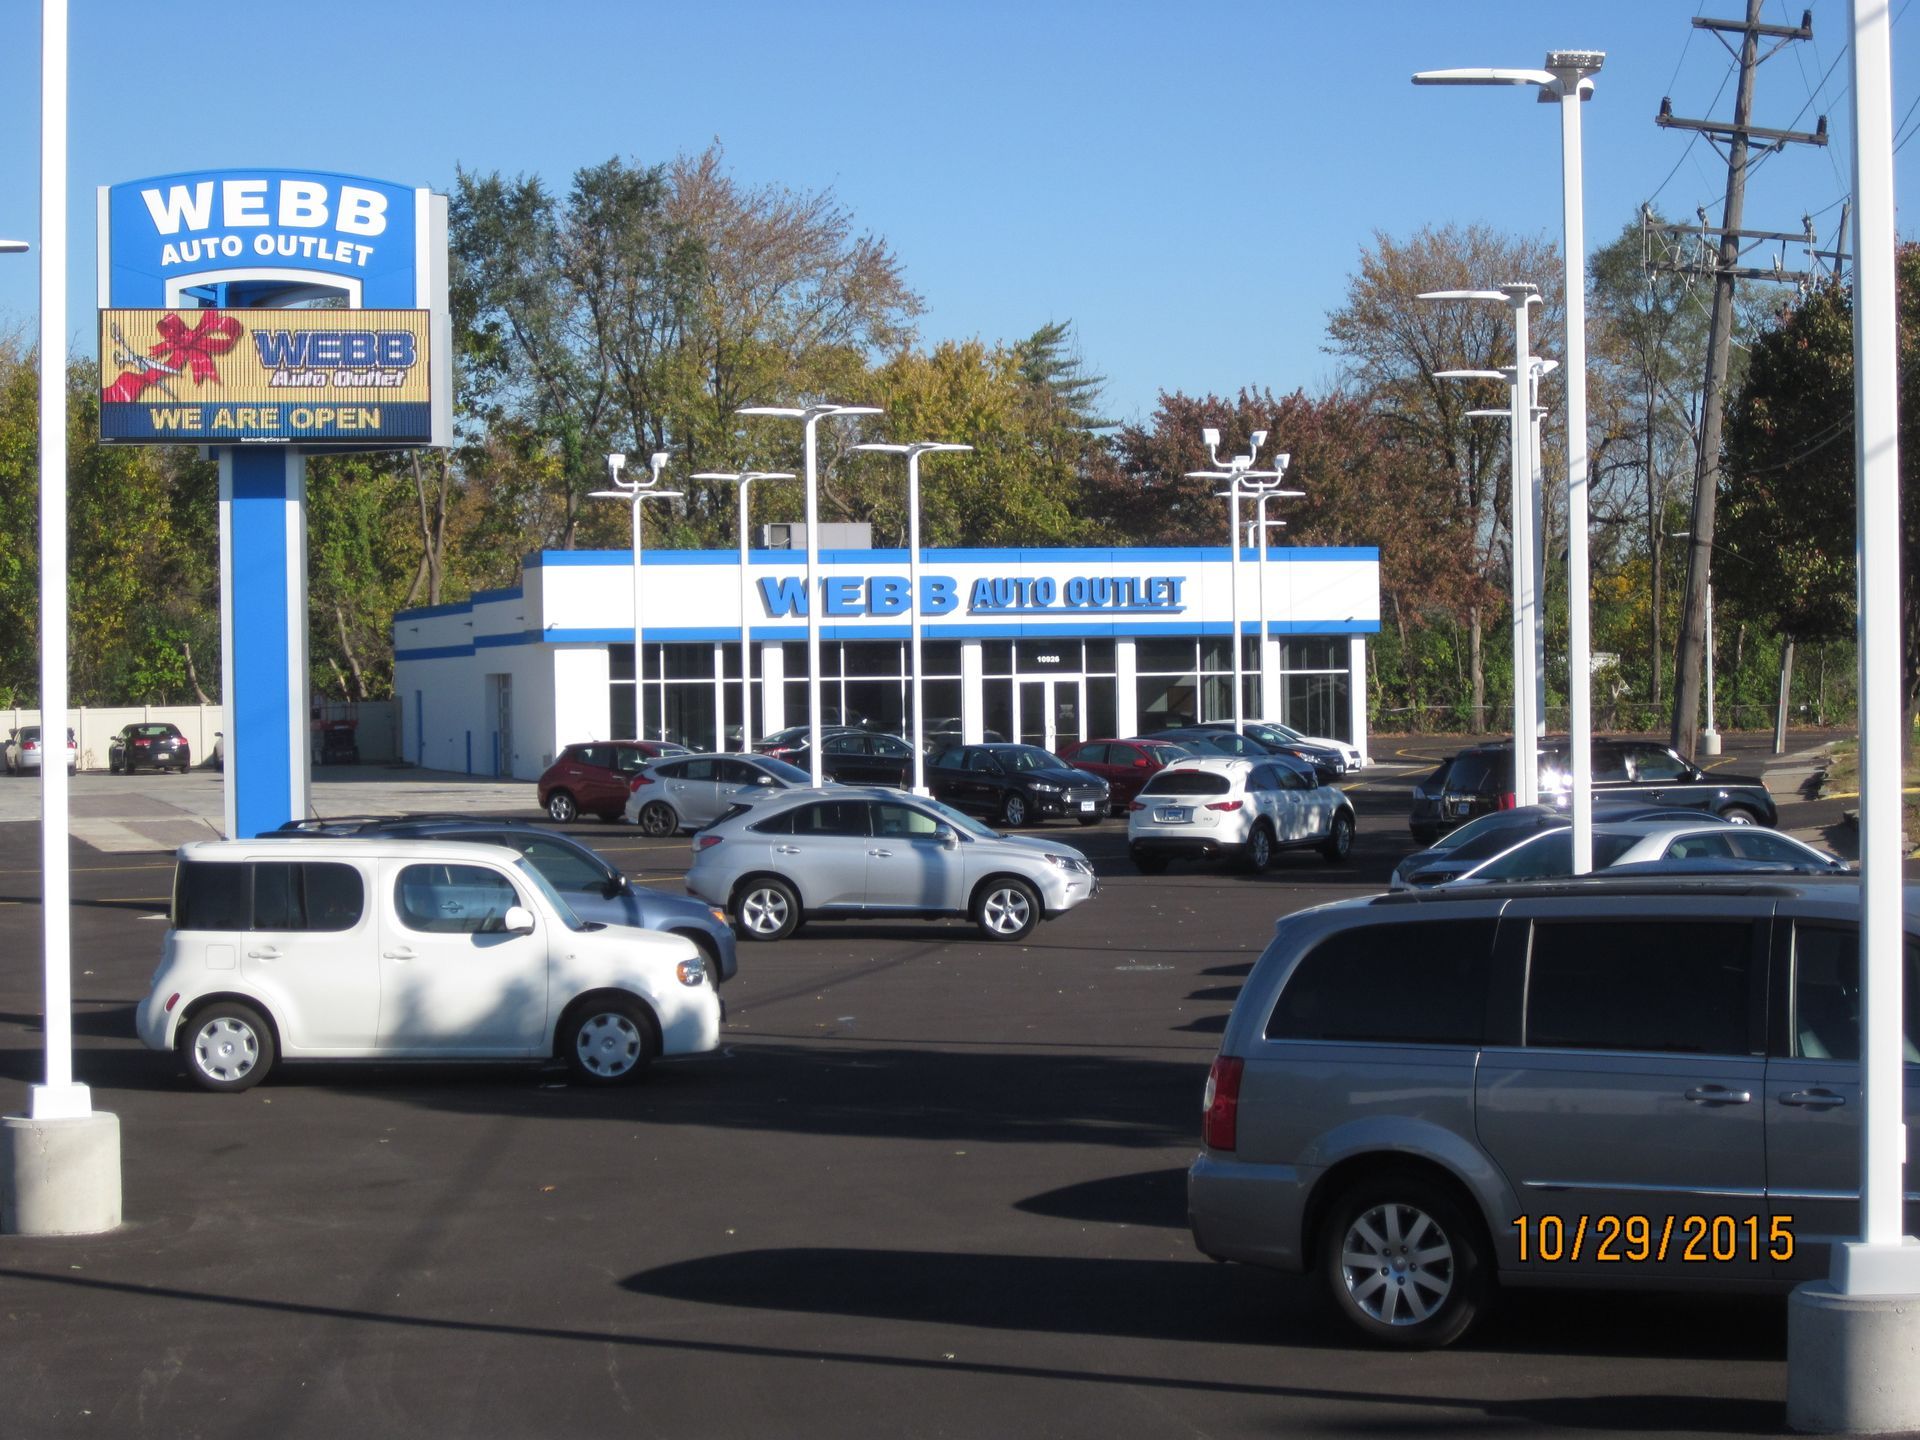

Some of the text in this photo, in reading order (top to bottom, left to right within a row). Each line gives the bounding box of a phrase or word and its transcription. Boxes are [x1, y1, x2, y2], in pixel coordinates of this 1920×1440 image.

[140, 179, 389, 237] WEBB
[161, 234, 374, 267] AUTO OUTLET
[251, 329, 417, 369] WEBB
[268, 367, 407, 388] Auto Outlet
[150, 407, 382, 430] WE ARE OPEN
[756, 576, 1187, 618] WEBB AUTO OUTLET
